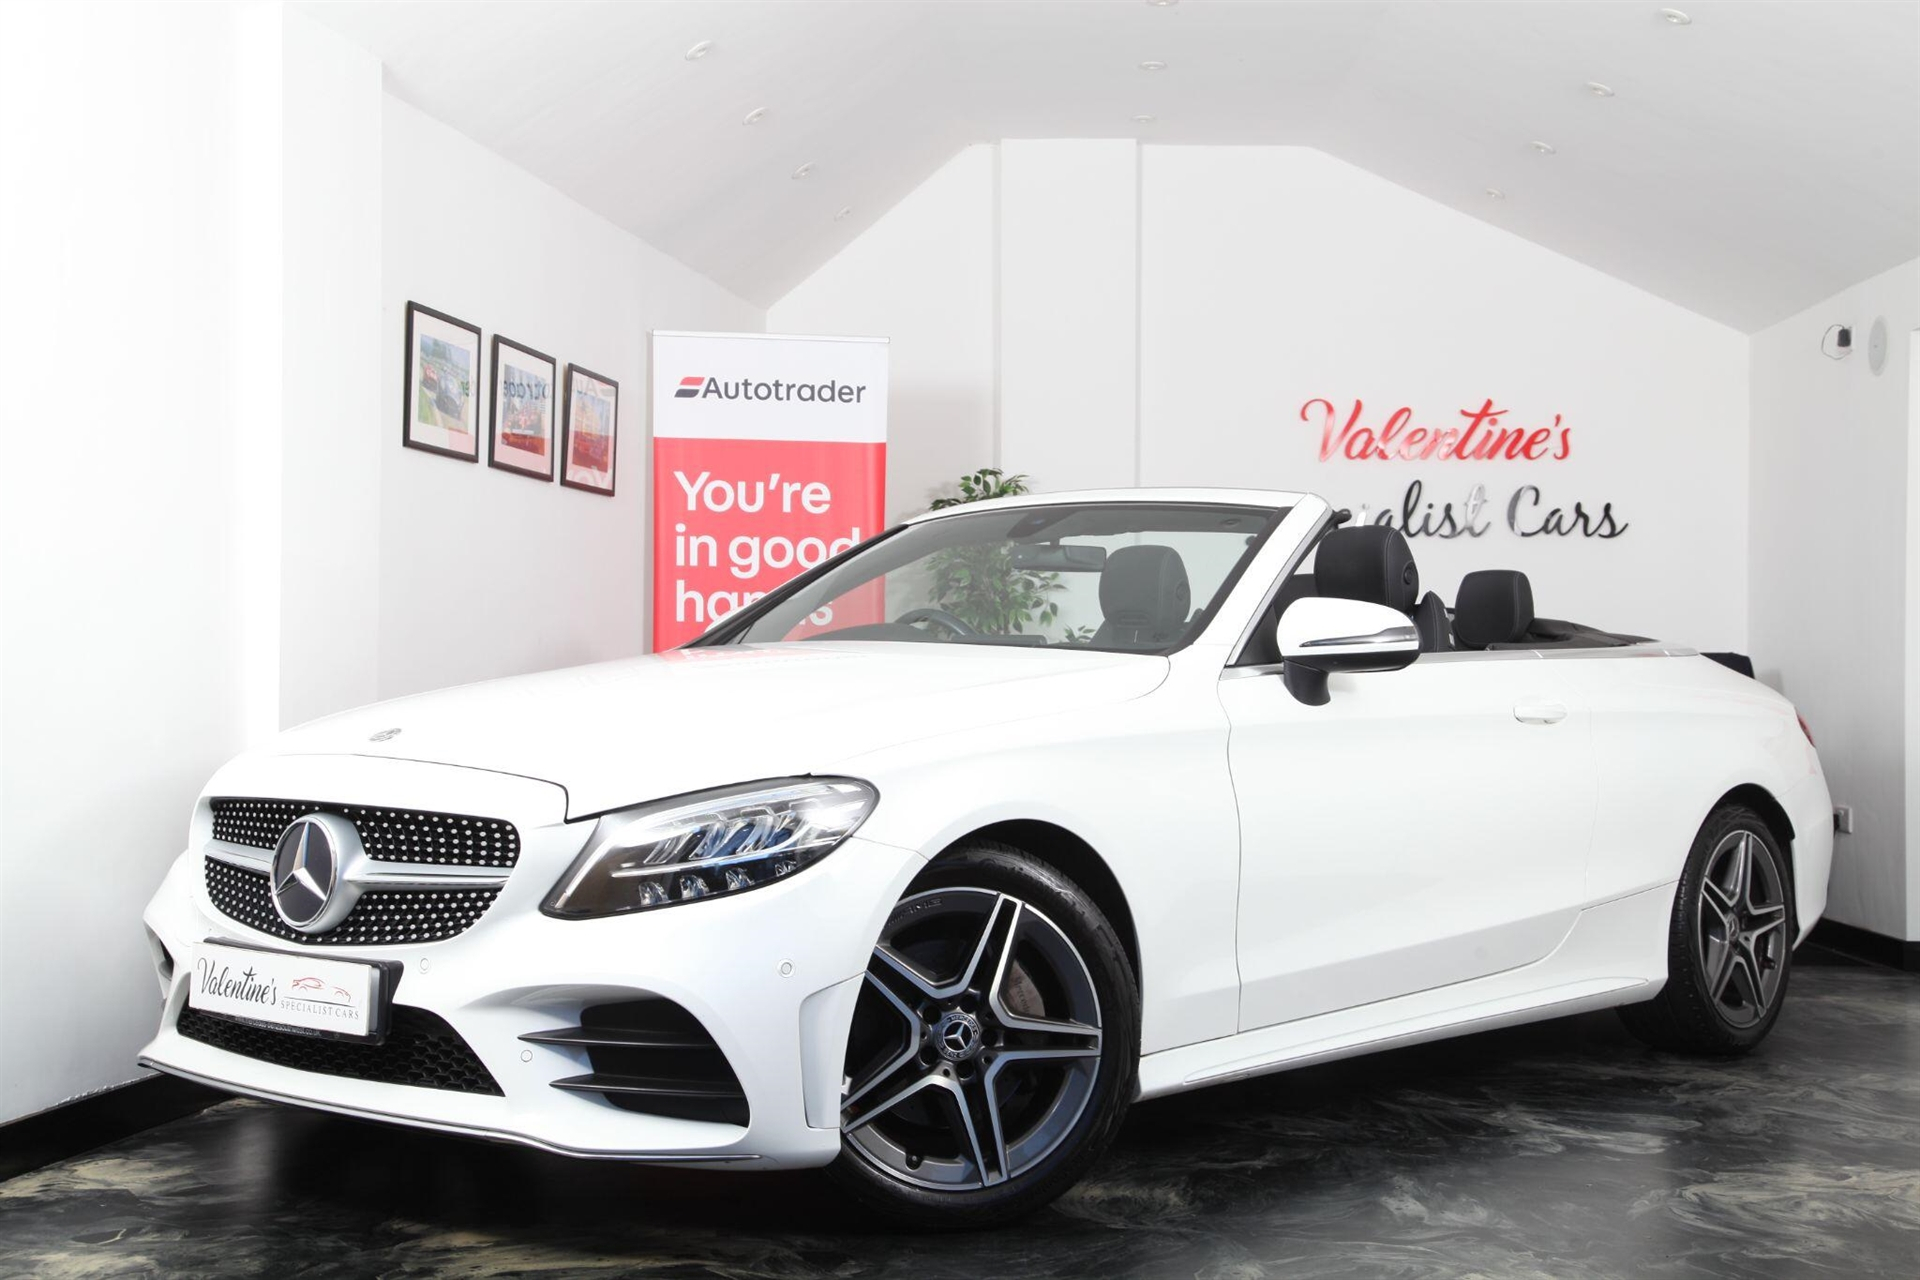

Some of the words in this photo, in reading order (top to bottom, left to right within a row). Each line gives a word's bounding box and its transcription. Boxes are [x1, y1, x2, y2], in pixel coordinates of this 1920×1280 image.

[702, 376, 866, 403] Autotrader
[1300, 397, 1571, 462] Valentine's
[673, 471, 831, 513] You're
[1506, 484, 1629, 538] Cars
[675, 523, 717, 566] in
[728, 526, 861, 579] good
[675, 579, 833, 625] has
[197, 957, 278, 1006] Valentine's
[280, 1000, 334, 1016] SPECIALIST
[335, 1007, 359, 1021] CARS
